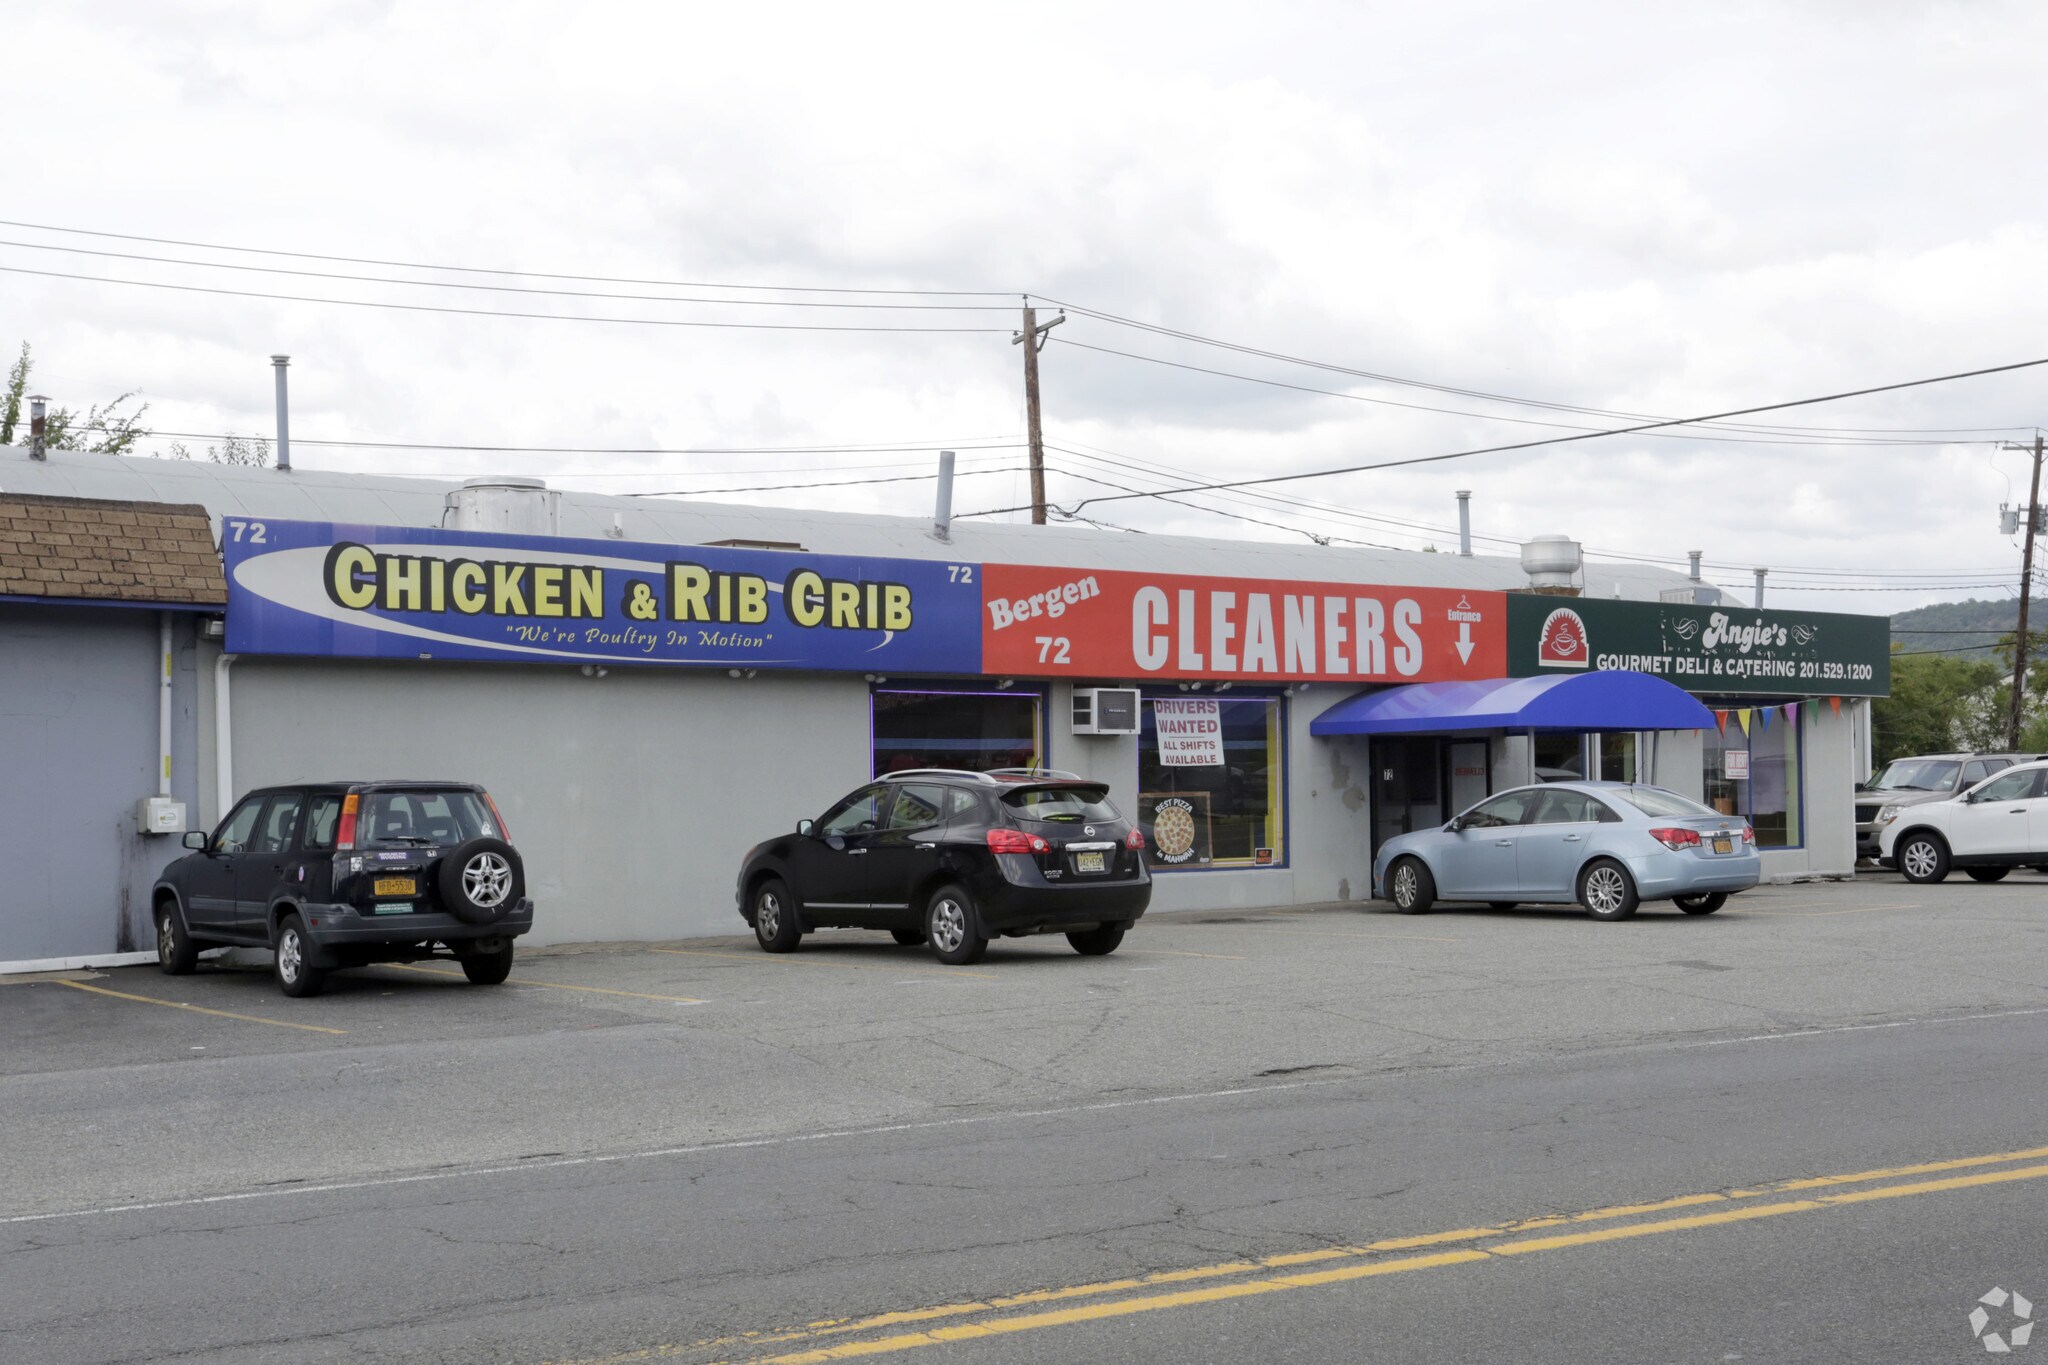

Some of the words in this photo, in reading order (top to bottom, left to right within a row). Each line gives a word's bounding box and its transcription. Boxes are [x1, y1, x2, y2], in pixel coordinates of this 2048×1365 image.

[230, 521, 267, 544] 72
[948, 566, 973, 583] 72
[323, 541, 605, 619] CHICKEN
[624, 580, 657, 620] &
[667, 562, 768, 623] RIB
[785, 568, 912, 630] CRIB
[987, 575, 1100, 630] Bergen
[1448, 609, 1481, 622] Entrance
[586, 627, 658, 652] Poultry
[666, 630, 688, 646] In
[1133, 585, 1423, 677] CLEANERS
[1702, 611, 1787, 654] Angie's
[1035, 636, 1071, 664] 72
[1596, 654, 1672, 676] GOURMET
[1675, 657, 1710, 676] DELI
[1712, 658, 1724, 676] &
[1726, 659, 1796, 678] CATERING
[1799, 664, 1873, 681] 201.529.1200
[1156, 700, 1217, 714] DRIVERS
[1158, 720, 1218, 733] WANTED
[1163, 741, 1178, 750] ALL
[1180, 741, 1216, 750] SHIFTS
[1165, 754, 1217, 764] AVAILABLE
[1155, 798, 1172, 814] BEST
[1173, 798, 1194, 814] PIZZA
[1164, 848, 1195, 863] MAHWAH
